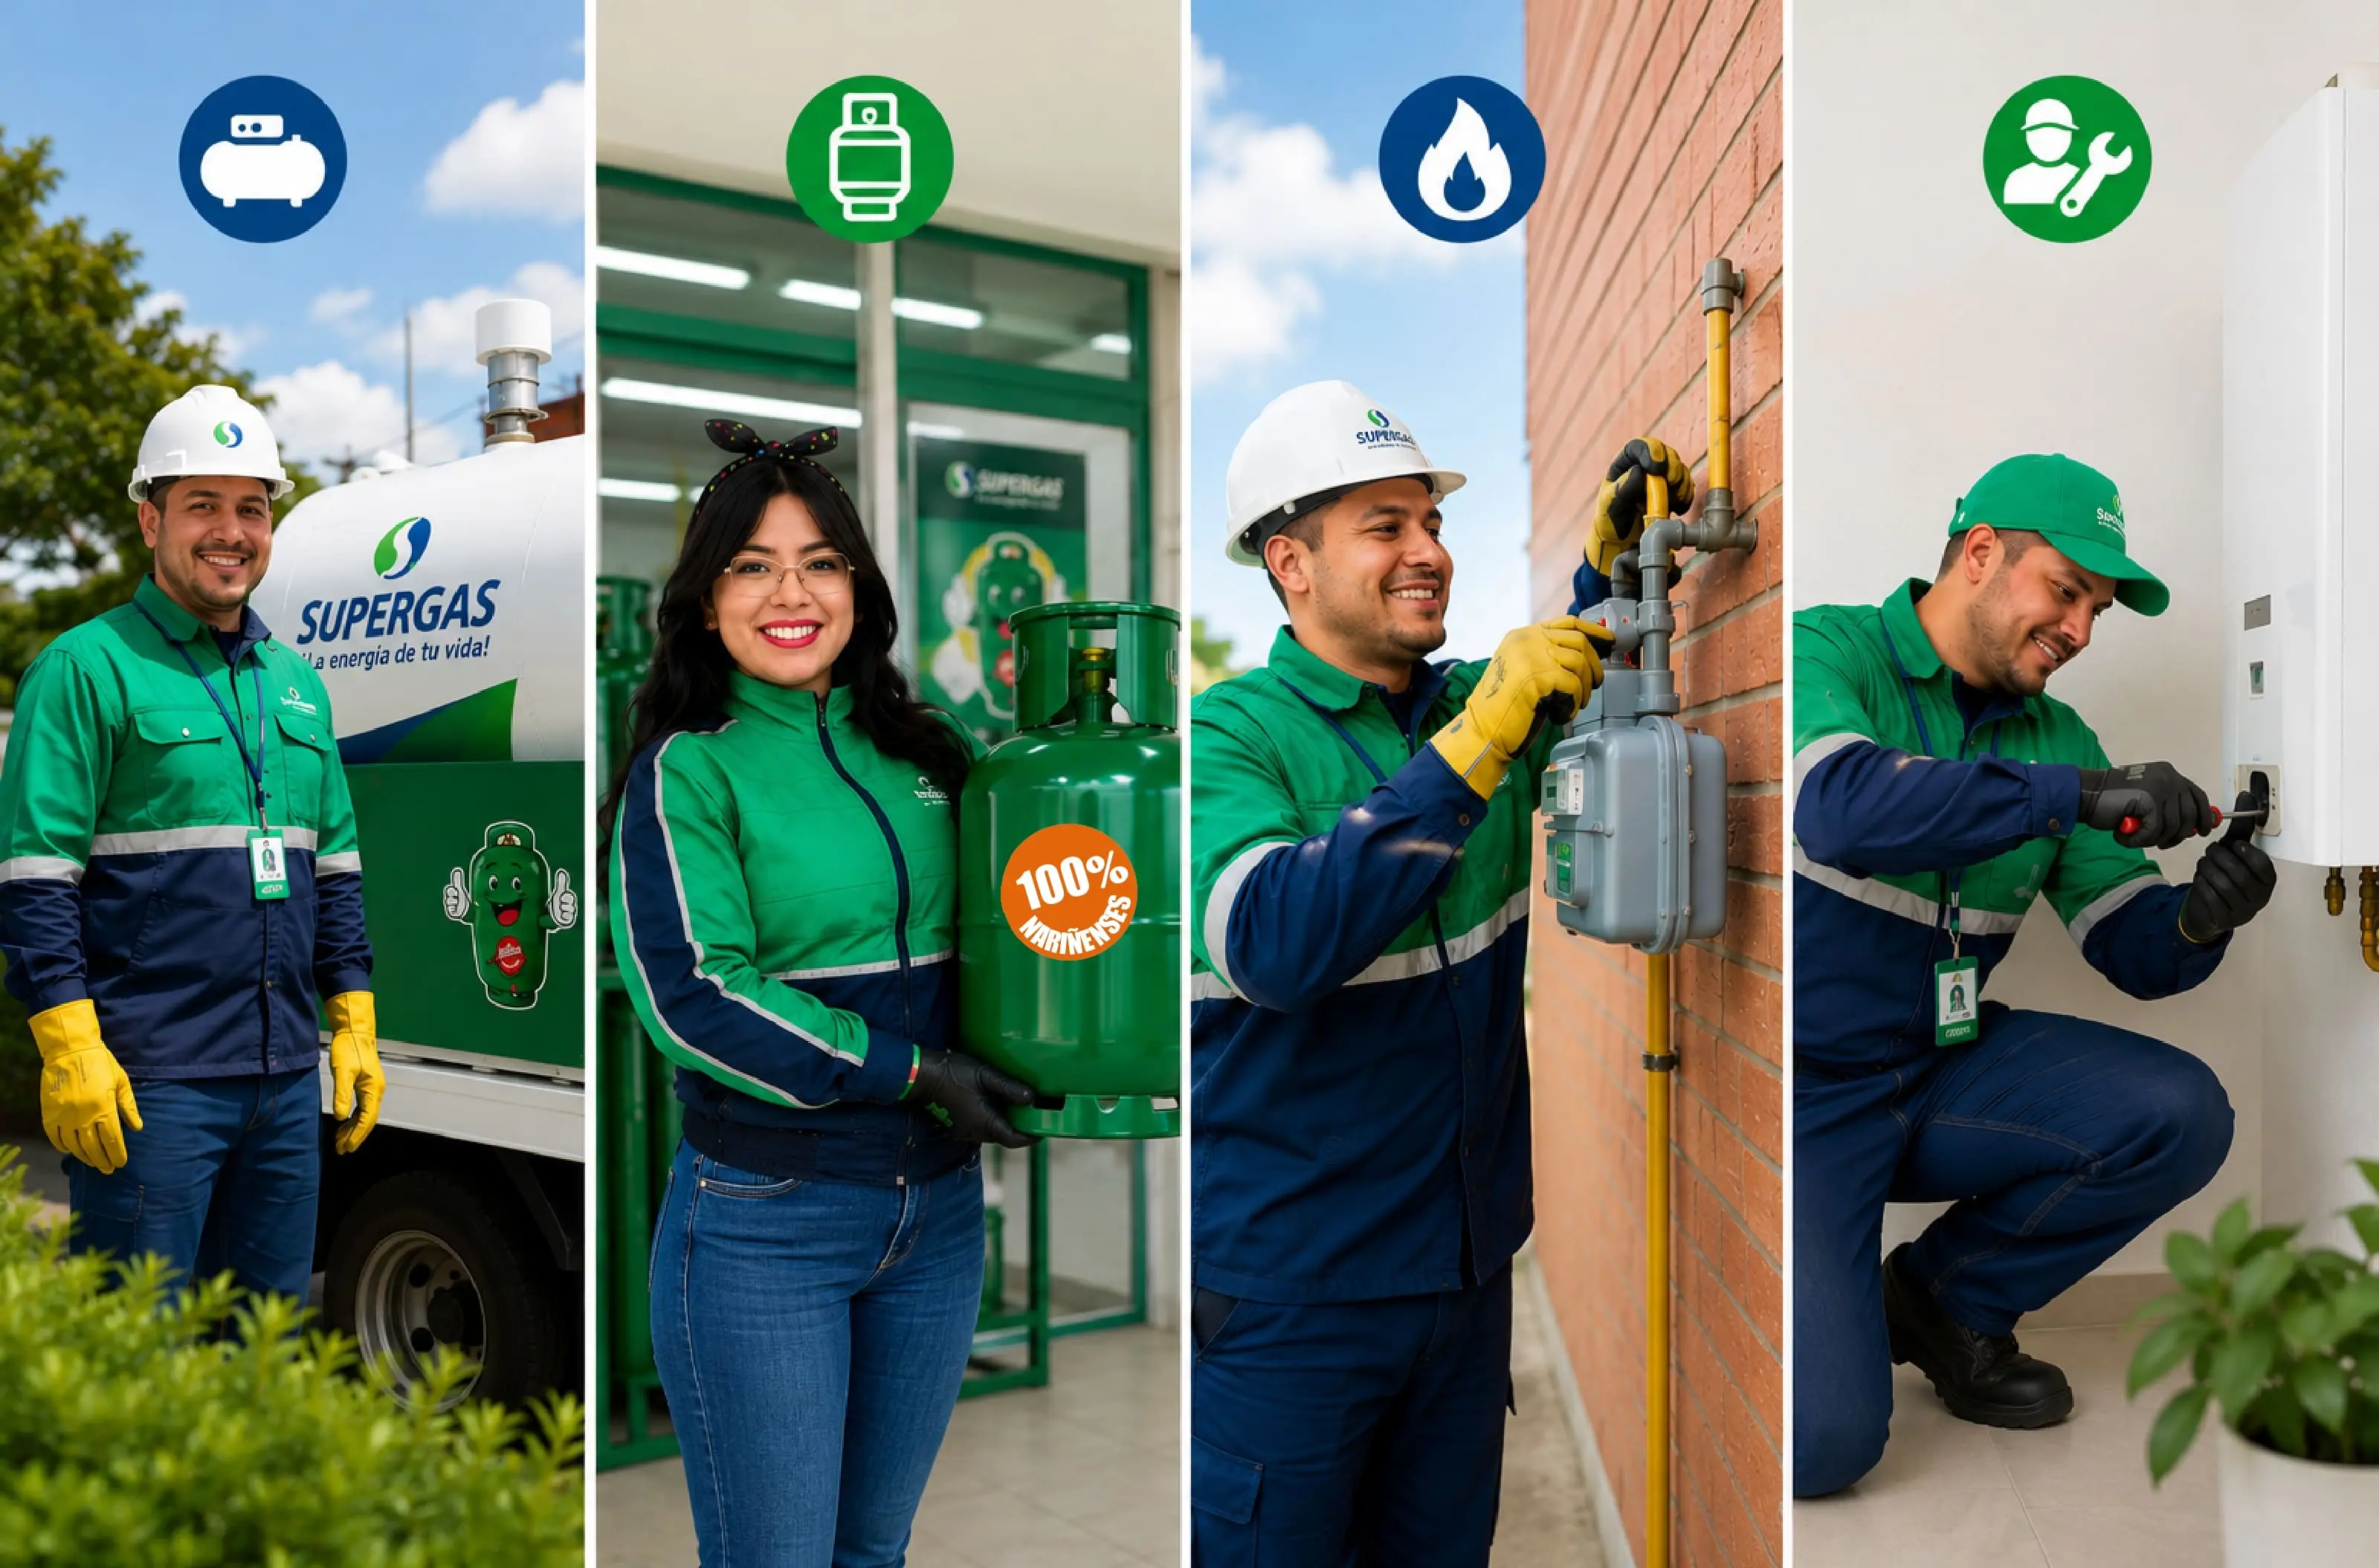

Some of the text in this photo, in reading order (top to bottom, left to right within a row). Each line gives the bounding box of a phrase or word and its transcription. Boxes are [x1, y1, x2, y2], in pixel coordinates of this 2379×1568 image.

[297, 579, 501, 645] SUPERGAS
[395, 642, 416, 663] de
[422, 642, 439, 660] tu
[446, 635, 491, 659] vida!
[1016, 850, 1129, 911] 100%
[1019, 894, 1132, 955] NARIÑENSES
